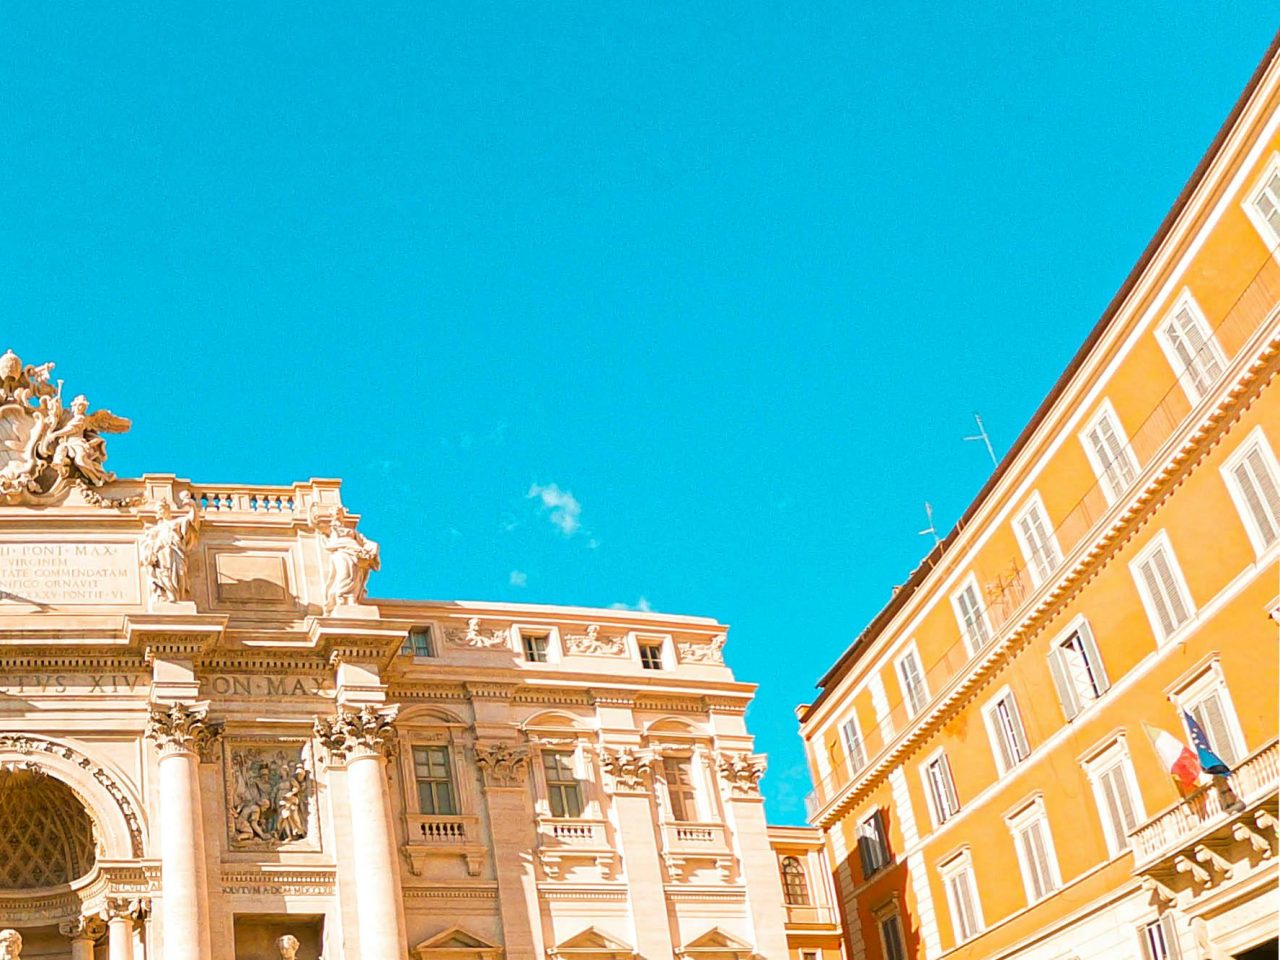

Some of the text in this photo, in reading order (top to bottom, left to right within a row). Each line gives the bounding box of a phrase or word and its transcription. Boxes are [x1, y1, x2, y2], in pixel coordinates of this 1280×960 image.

[8, 558, 68, 567] VIRGINEM
[33, 568, 128, 578] COMMENDATAM
[44, 579, 99, 588] ORNAVIT
[263, 676, 328, 697] MAX
